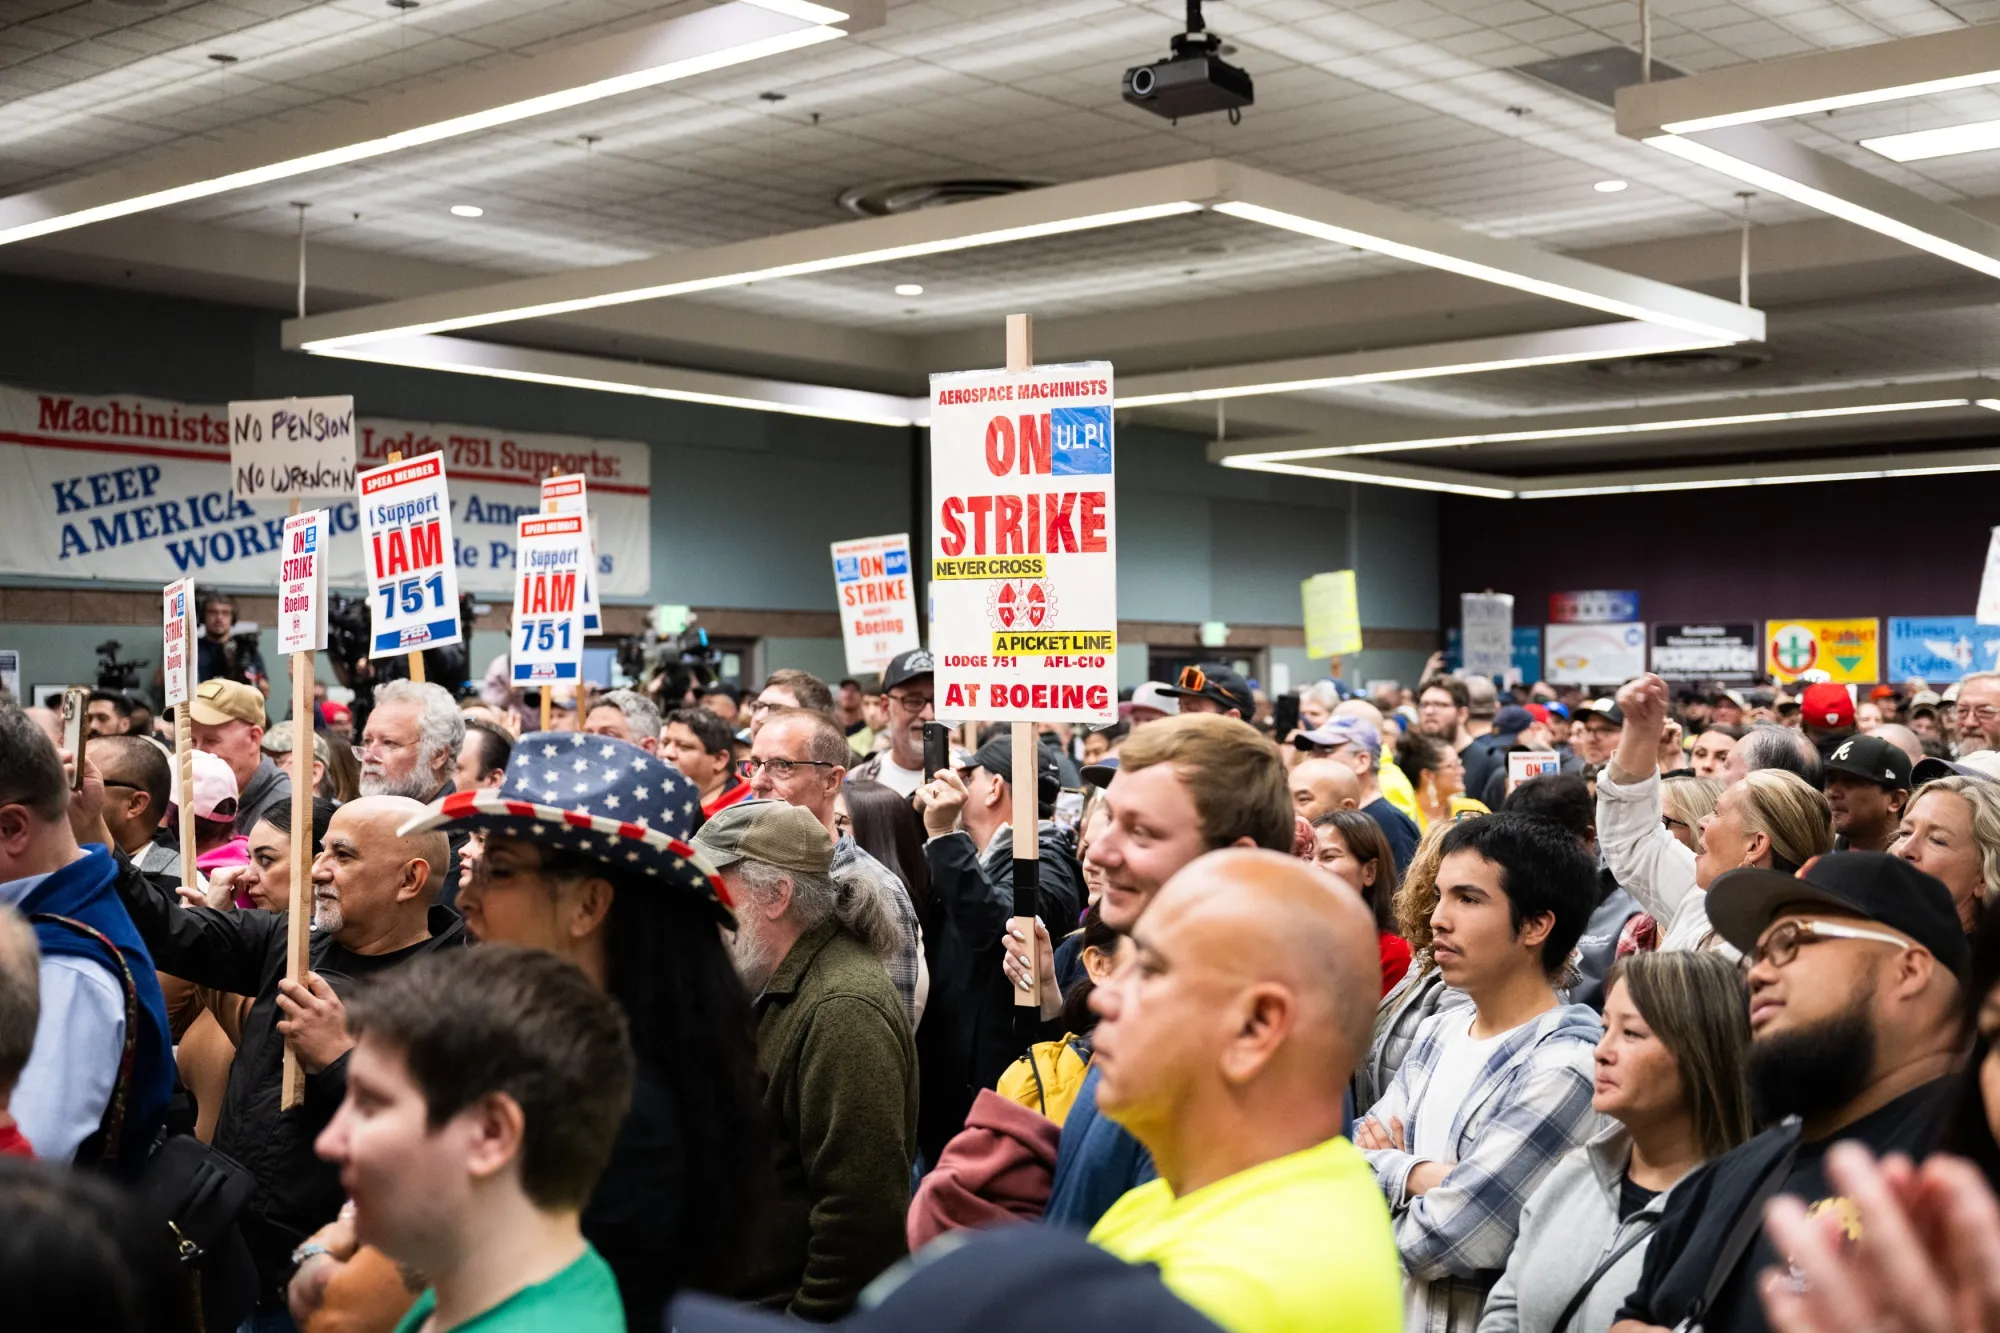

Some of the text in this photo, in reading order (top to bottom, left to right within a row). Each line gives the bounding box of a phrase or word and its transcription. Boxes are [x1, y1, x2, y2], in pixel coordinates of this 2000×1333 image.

[938, 379, 1108, 406] AEROSPACE MACHINISTS
[38, 396, 229, 445] Machinists
[449, 436, 494, 469] 751
[235, 408, 353, 444] NO PENSION
[1057, 422, 1105, 450] ULP!
[985, 413, 1052, 477] ON
[52, 463, 161, 515] KEEP
[237, 463, 264, 494] NO
[367, 464, 435, 491] SPEEA MEMBER
[369, 510, 374, 528] I
[379, 492, 439, 527] Support
[58, 488, 255, 560] AMERICA
[940, 491, 1108, 557] STRIKE
[293, 530, 305, 555] ON
[372, 517, 444, 580] IAM
[283, 555, 313, 583] STRIKE
[524, 552, 528, 568] I
[531, 548, 578, 574] Support
[861, 556, 883, 578] ON
[936, 558, 1043, 577] NEVER CROSS
[284, 594, 309, 614] Boeing
[379, 572, 445, 620] 751
[522, 569, 577, 615] IAM
[844, 579, 907, 606] STRIKE
[166, 618, 183, 643] STRIKE
[521, 618, 571, 652] 751
[855, 618, 904, 636] Boeing
[996, 635, 1112, 651] A PICKET LINE
[944, 655, 988, 668] LODGE
[992, 656, 1017, 668] 751
[1044, 656, 1106, 669] AFL-CIO
[945, 683, 1108, 709] AT BOEING
[1526, 763, 1541, 777] ON
